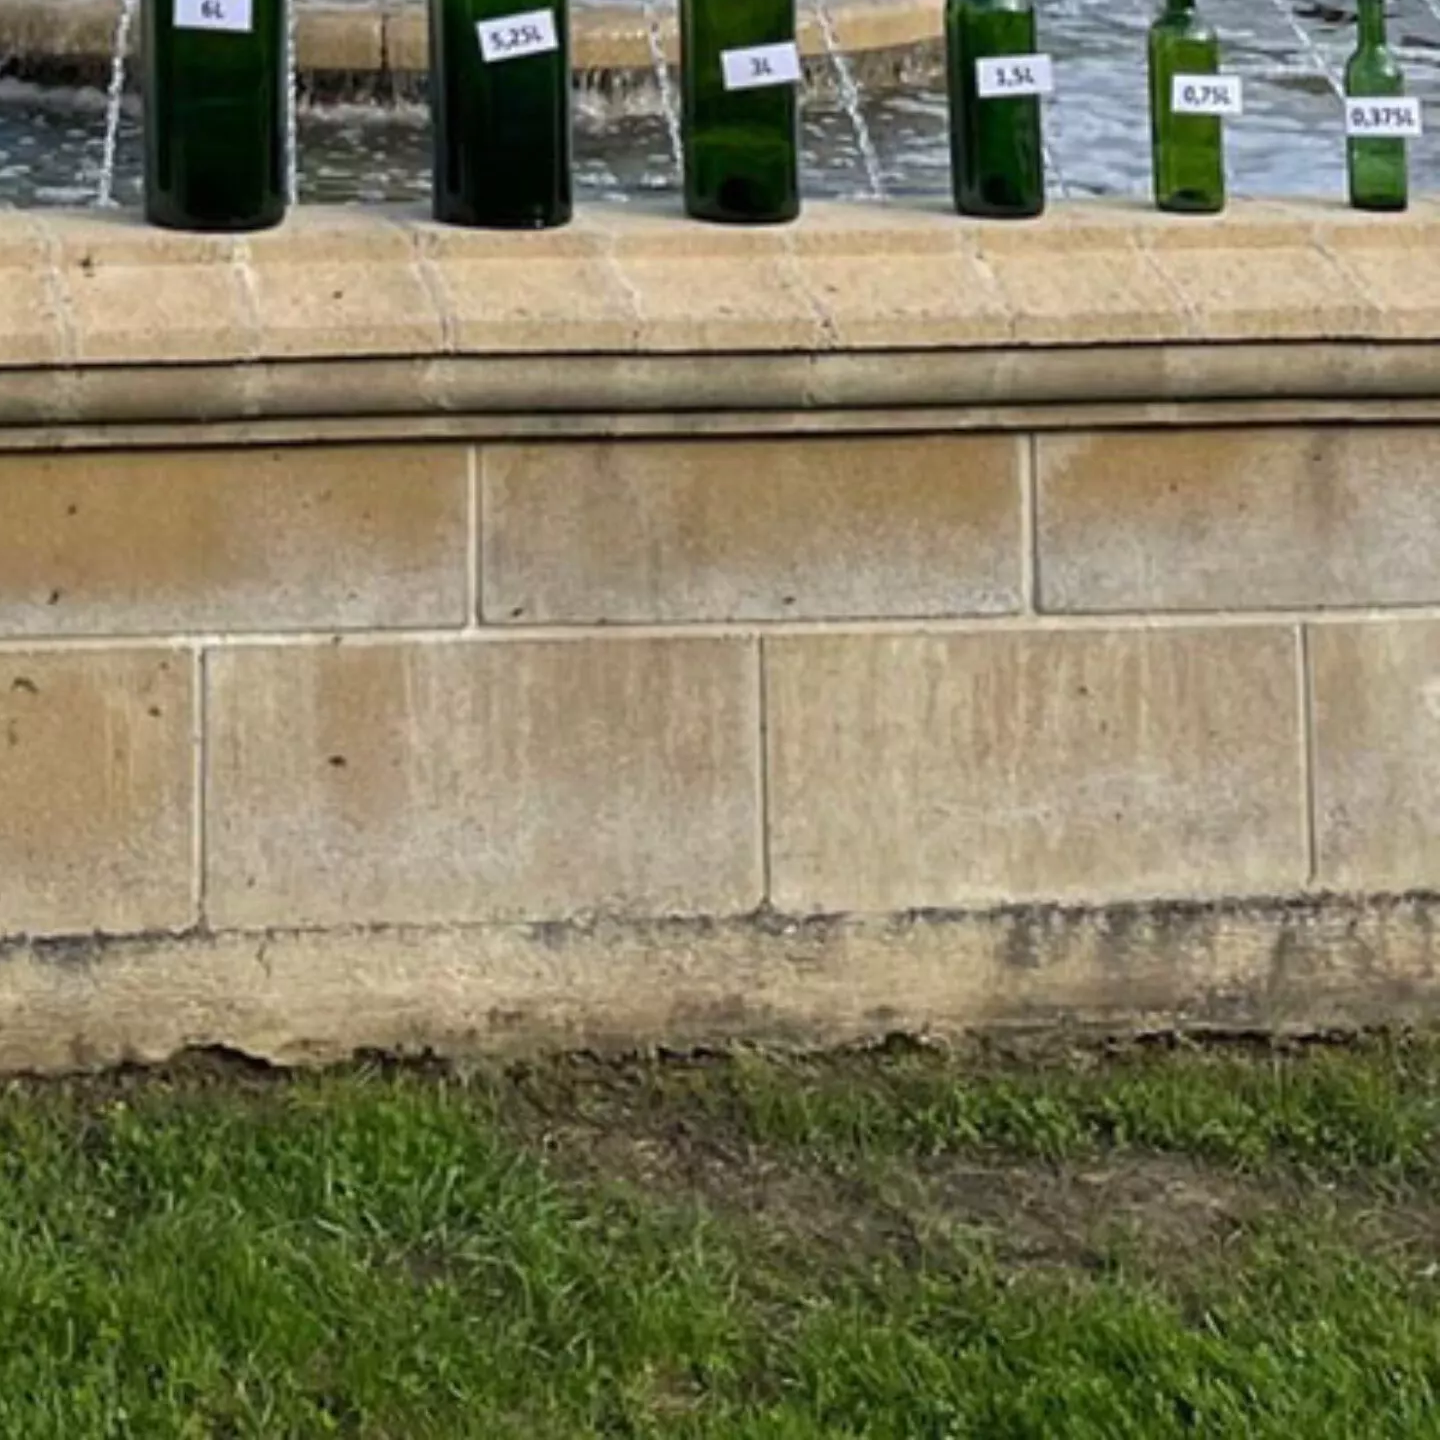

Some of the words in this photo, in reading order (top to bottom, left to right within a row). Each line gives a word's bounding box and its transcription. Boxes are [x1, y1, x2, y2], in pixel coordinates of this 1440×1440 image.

[489, 23, 544, 51] 5,25L
[750, 56, 772, 76] 3L
[995, 67, 1035, 87] 1,5L
[1183, 85, 1231, 105] 0,75L
[1350, 106, 1414, 127] 0,375L
